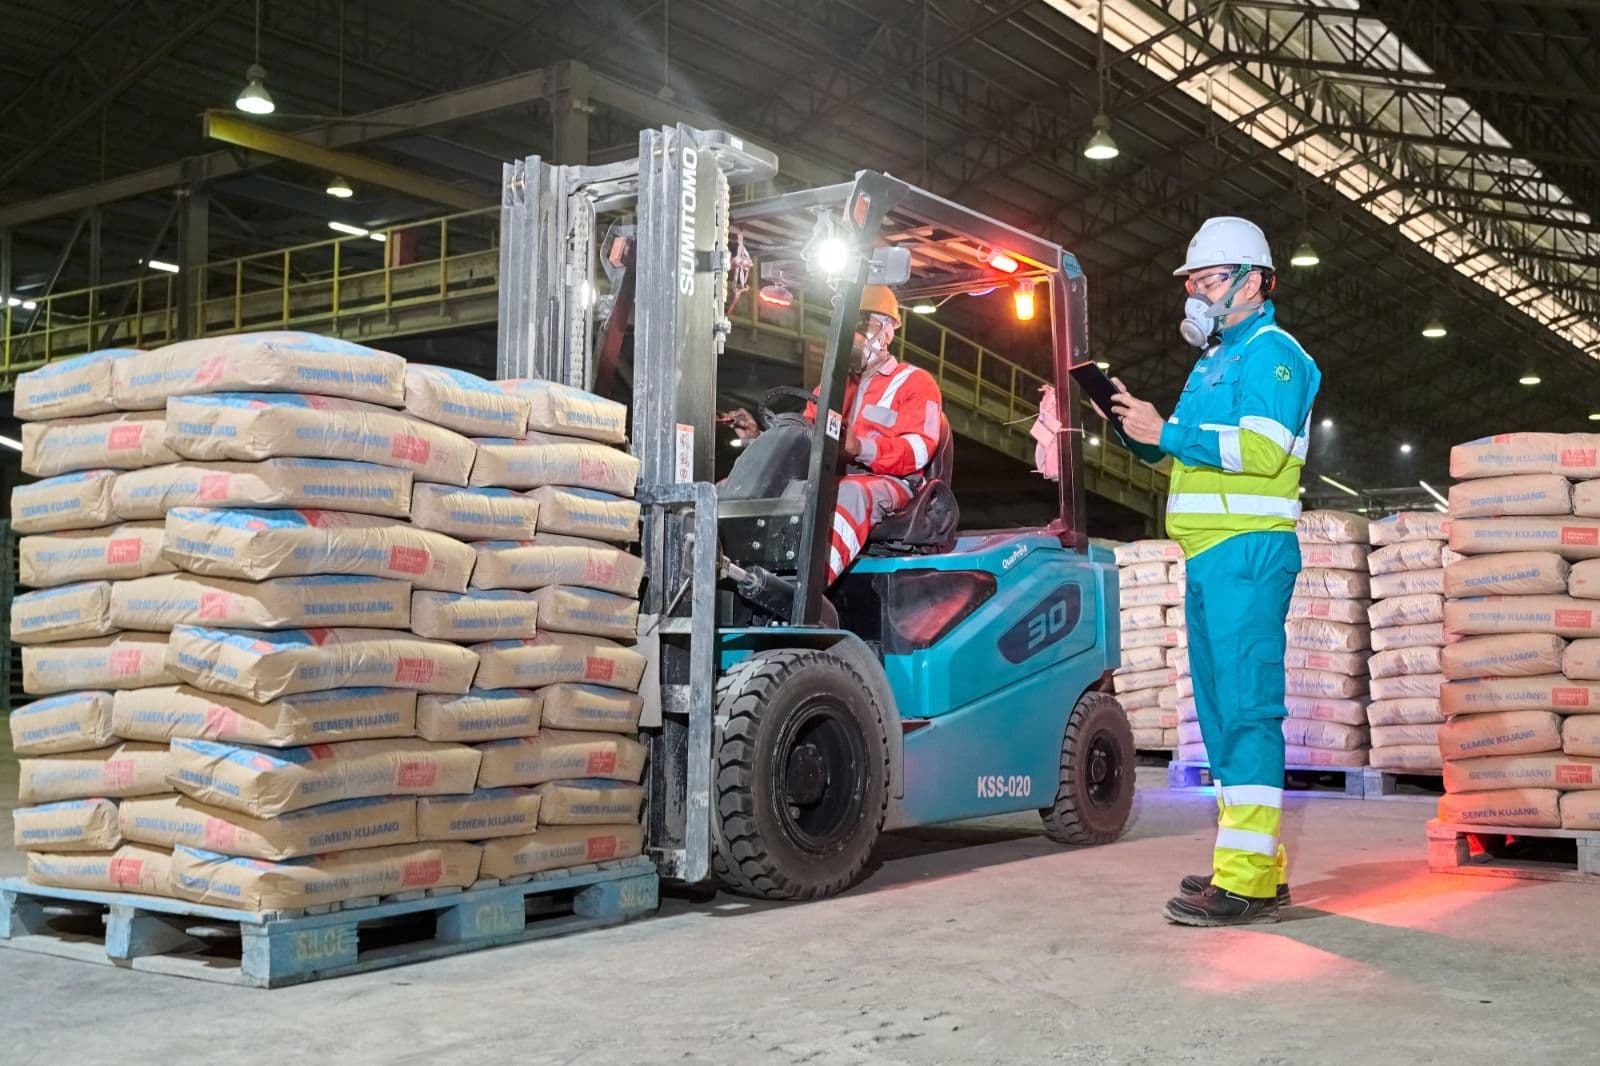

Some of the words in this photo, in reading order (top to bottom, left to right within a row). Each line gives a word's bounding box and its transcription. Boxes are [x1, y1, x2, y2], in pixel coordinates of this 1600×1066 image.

[680, 147, 698, 296] SUMITOMO
[1027, 599, 1067, 650] 30
[312, 718, 354, 732] SEMEN
[356, 712, 401, 727] KUJANG
[458, 718, 493, 731] SEMEN
[1460, 738, 1494, 751] SEMEN
[1496, 730, 1536, 744] KUJANG
[977, 775, 1031, 798] KSS-020
[450, 818, 487, 831] SEMEN
[488, 814, 526, 828] KUJANG
[1462, 810, 1498, 820] SEMEN
[1500, 808, 1538, 817] KUJANG
[310, 830, 352, 847] SEMEN
[354, 822, 400, 838] KUJANG
